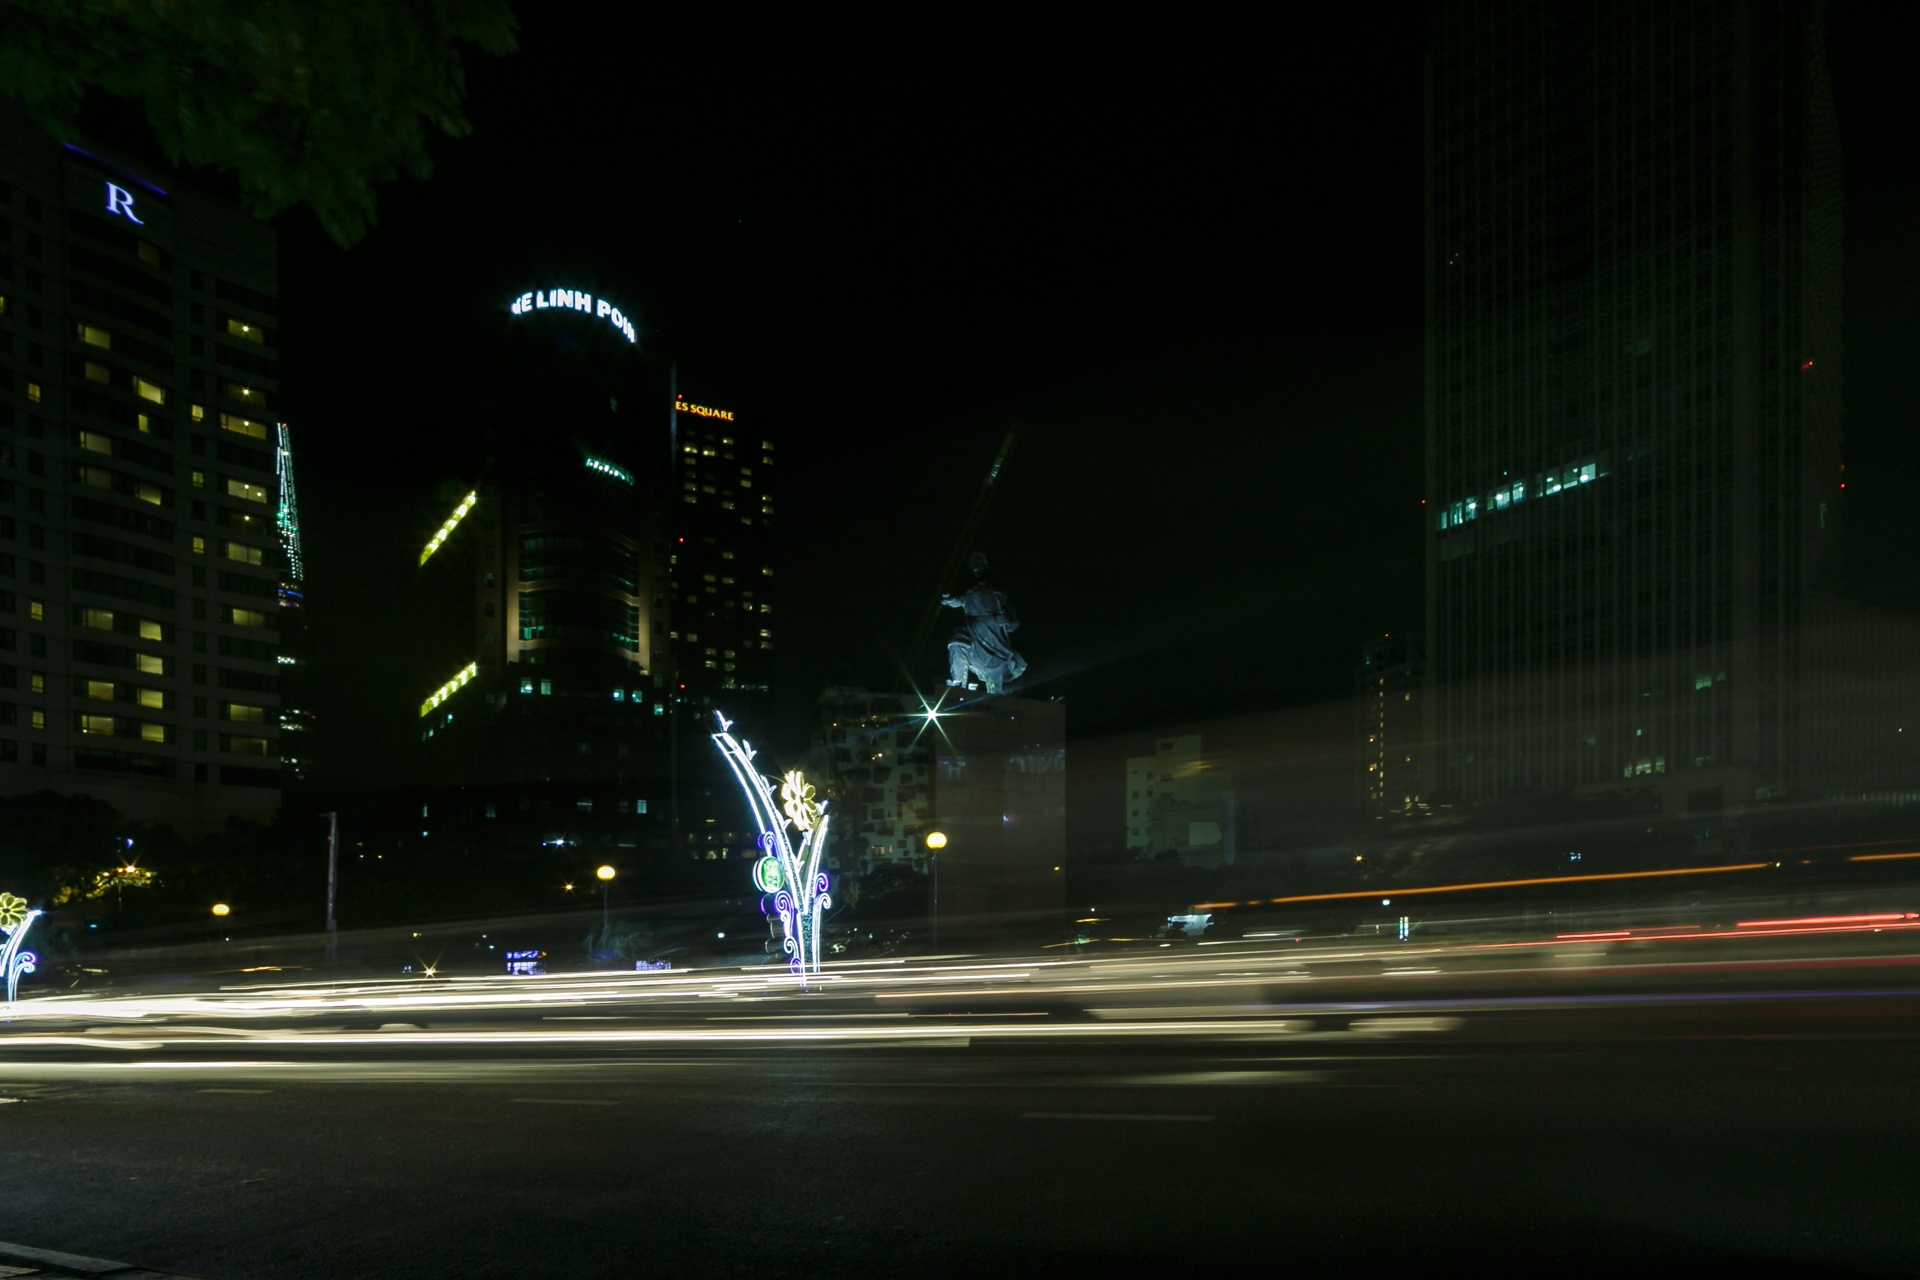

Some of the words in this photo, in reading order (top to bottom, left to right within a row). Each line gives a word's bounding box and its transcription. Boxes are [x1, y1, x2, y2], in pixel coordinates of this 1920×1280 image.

[106, 181, 144, 225] R
[536, 289, 592, 313] LINH
[675, 401, 689, 412] ES
[690, 404, 734, 421] SQUARE
